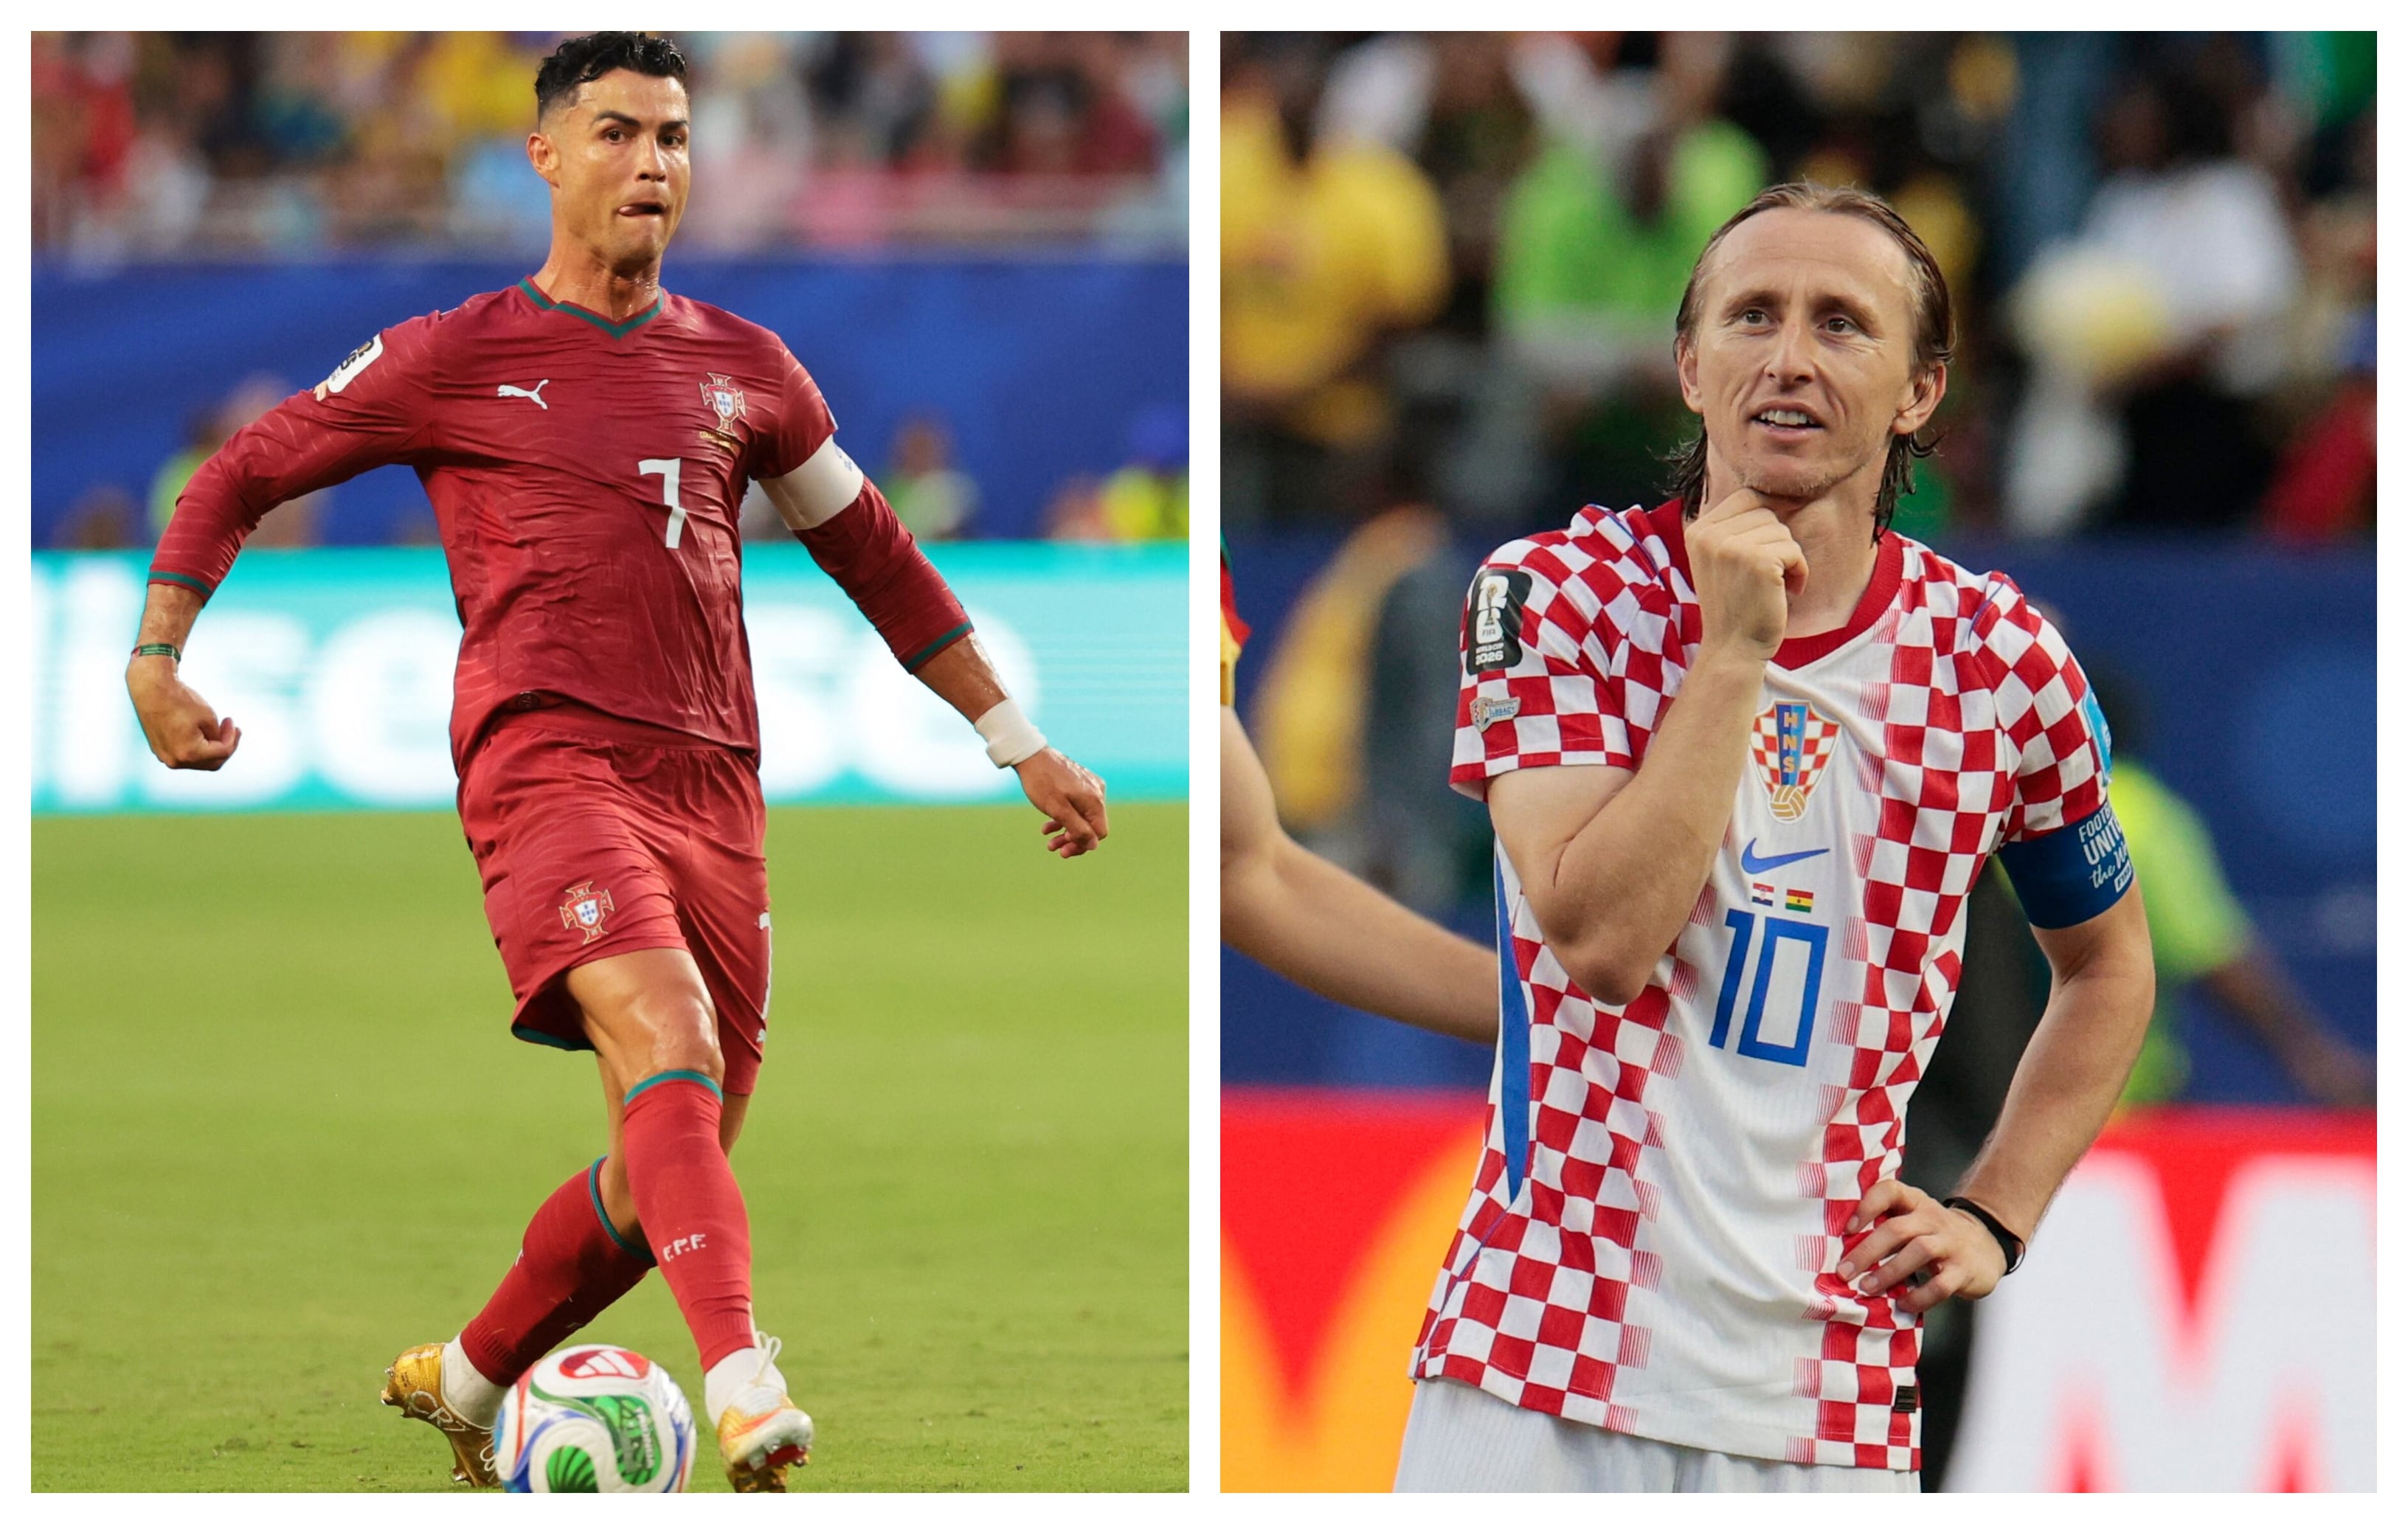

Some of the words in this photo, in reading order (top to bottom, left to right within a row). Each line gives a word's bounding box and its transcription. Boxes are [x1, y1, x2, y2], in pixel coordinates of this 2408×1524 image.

[637, 457, 681, 549] 7
[1475, 650, 1504, 665] 2026
[2089, 864, 2116, 889] the
[1708, 908, 1830, 1067] 10
[410, 1390, 471, 1432] CR7
